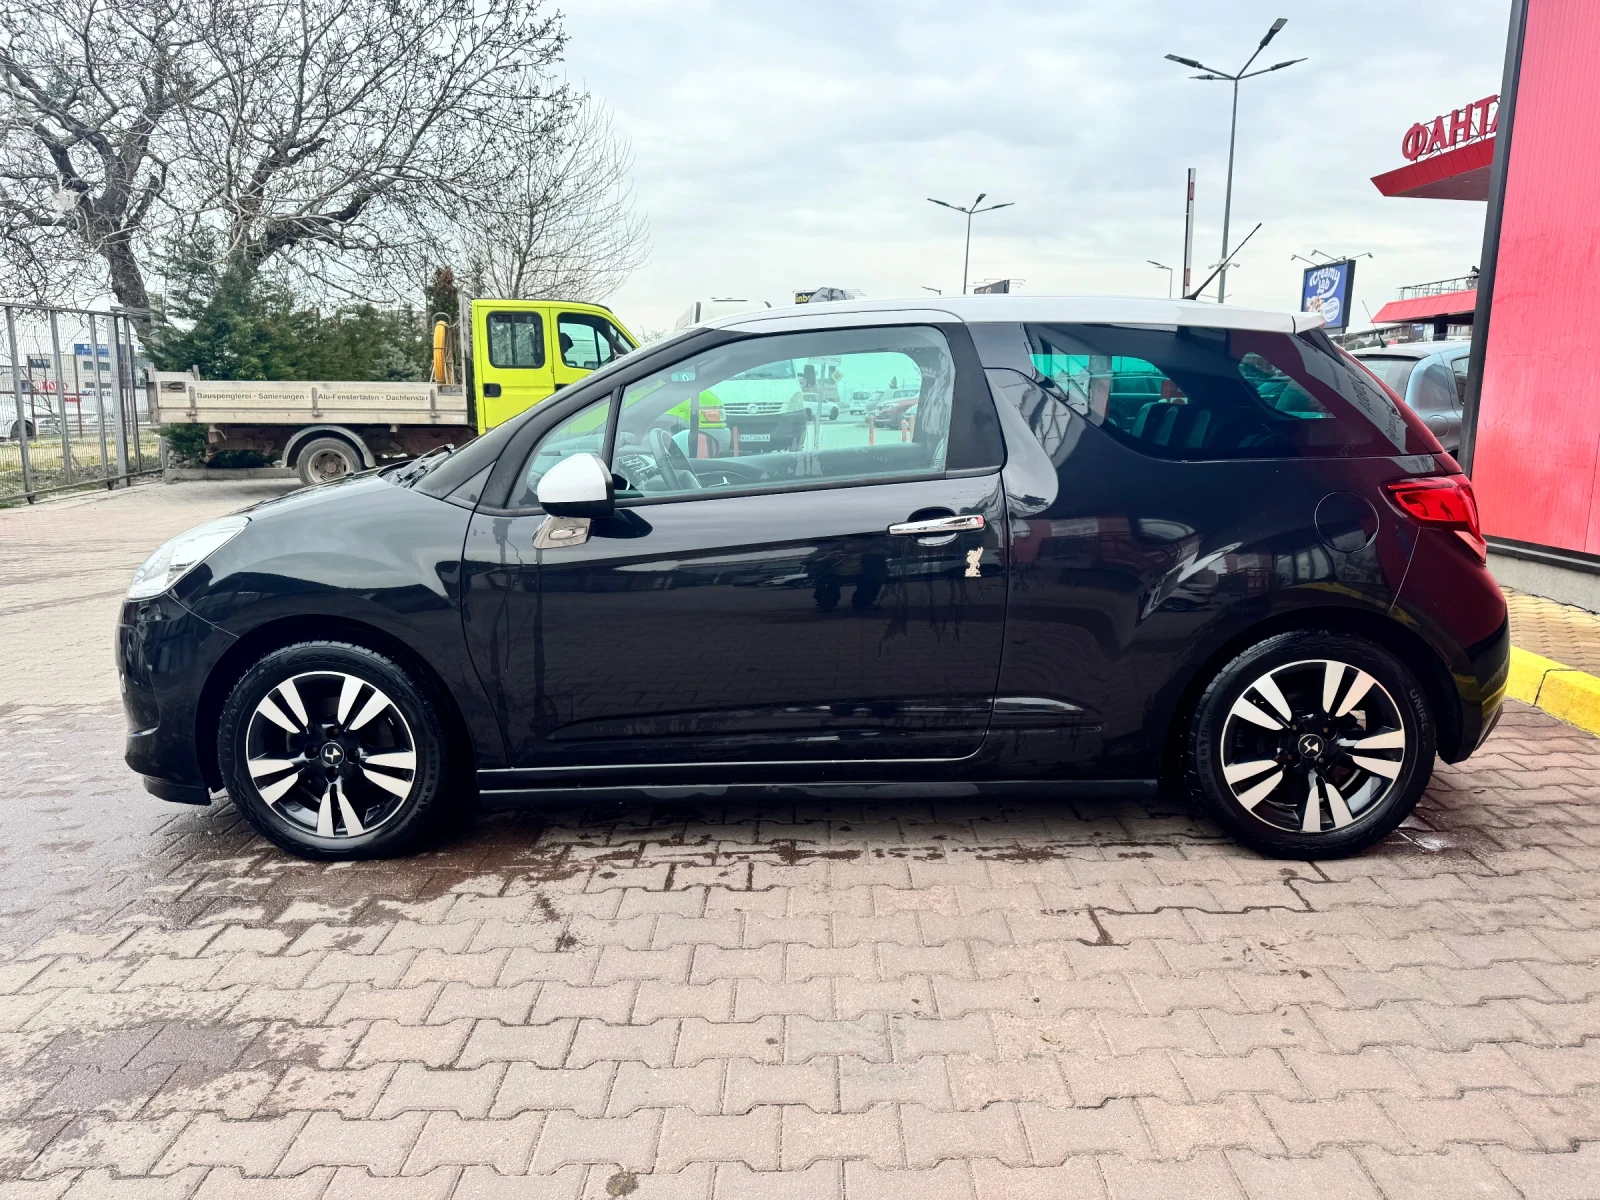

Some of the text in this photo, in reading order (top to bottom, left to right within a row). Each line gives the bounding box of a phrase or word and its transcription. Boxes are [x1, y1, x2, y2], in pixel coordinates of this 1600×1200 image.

[197, 392, 305, 401] Bauspenglerei Sanierungen
[317, 393, 380, 401] Alu-Fensterläden
